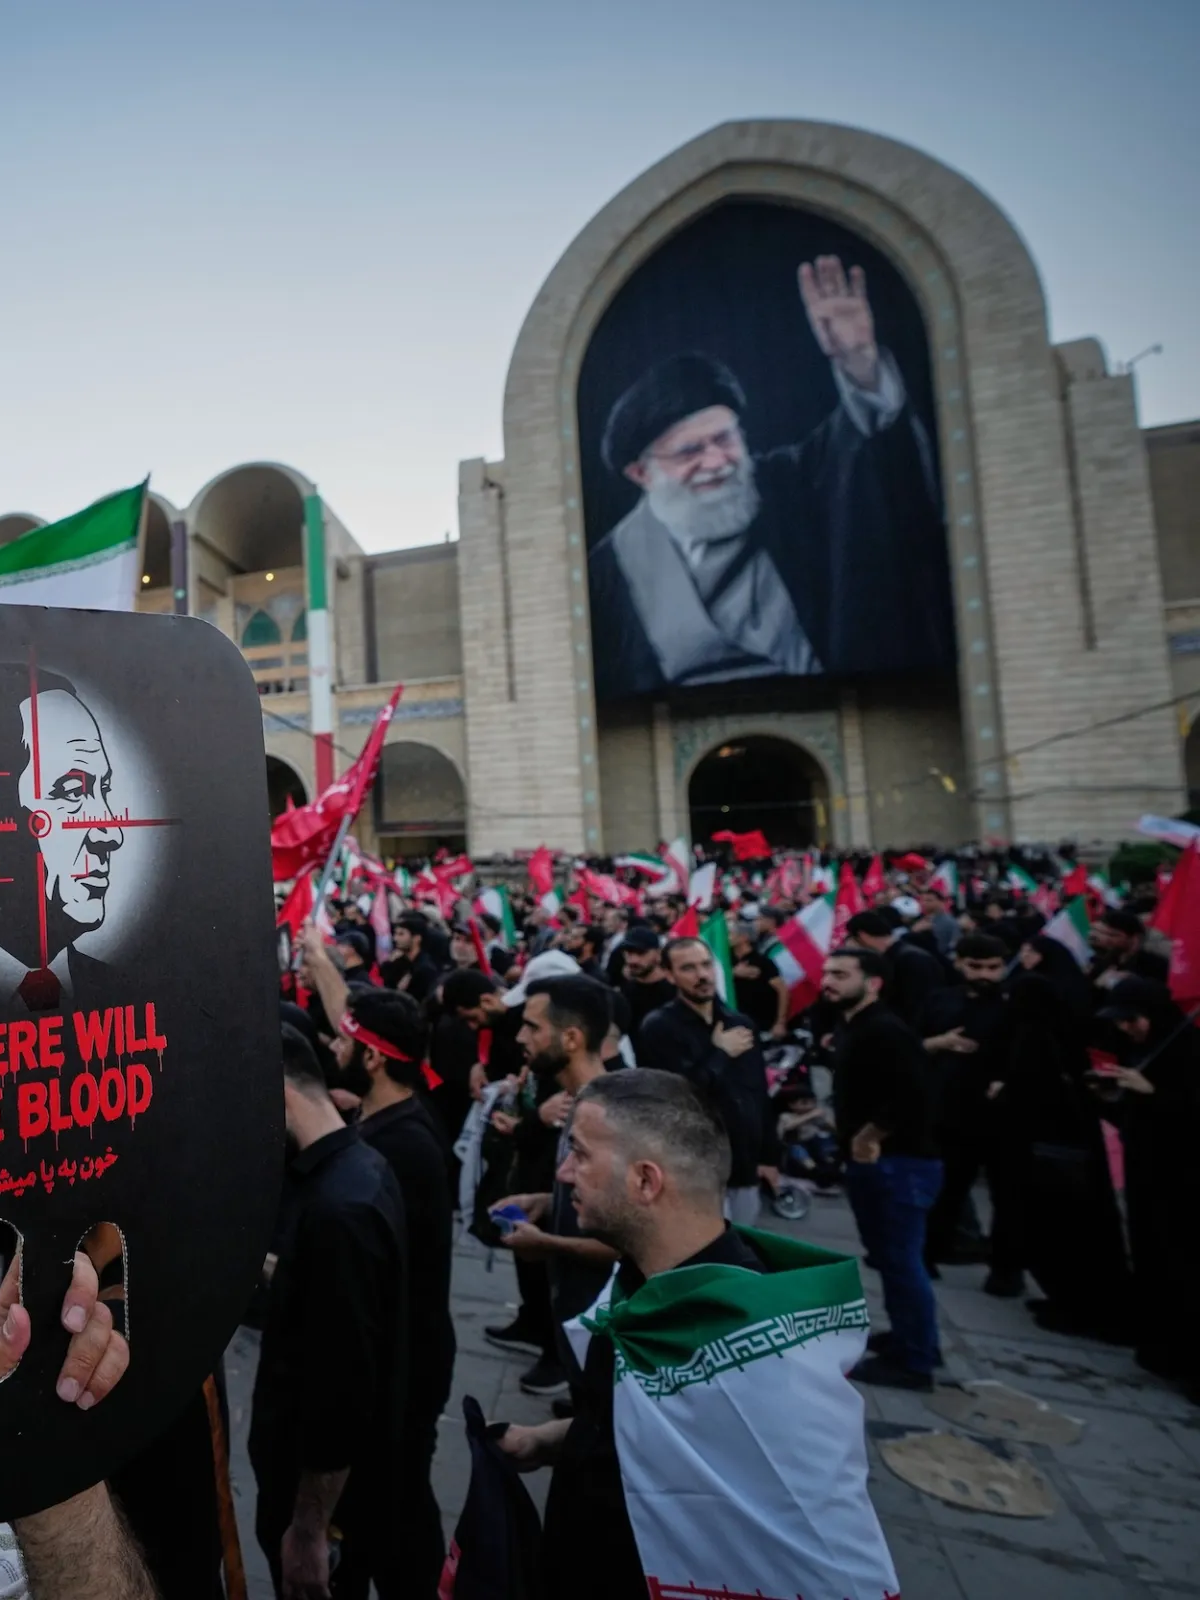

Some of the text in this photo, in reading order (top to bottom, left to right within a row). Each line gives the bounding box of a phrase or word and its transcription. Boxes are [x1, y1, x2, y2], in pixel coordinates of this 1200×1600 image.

[72, 1002, 167, 1064] WILL
[18, 1064, 153, 1141] BLOOD
[40, 1158, 55, 1194] پا
[58, 1158, 77, 1186] به
[80, 1146, 118, 1181] خون
